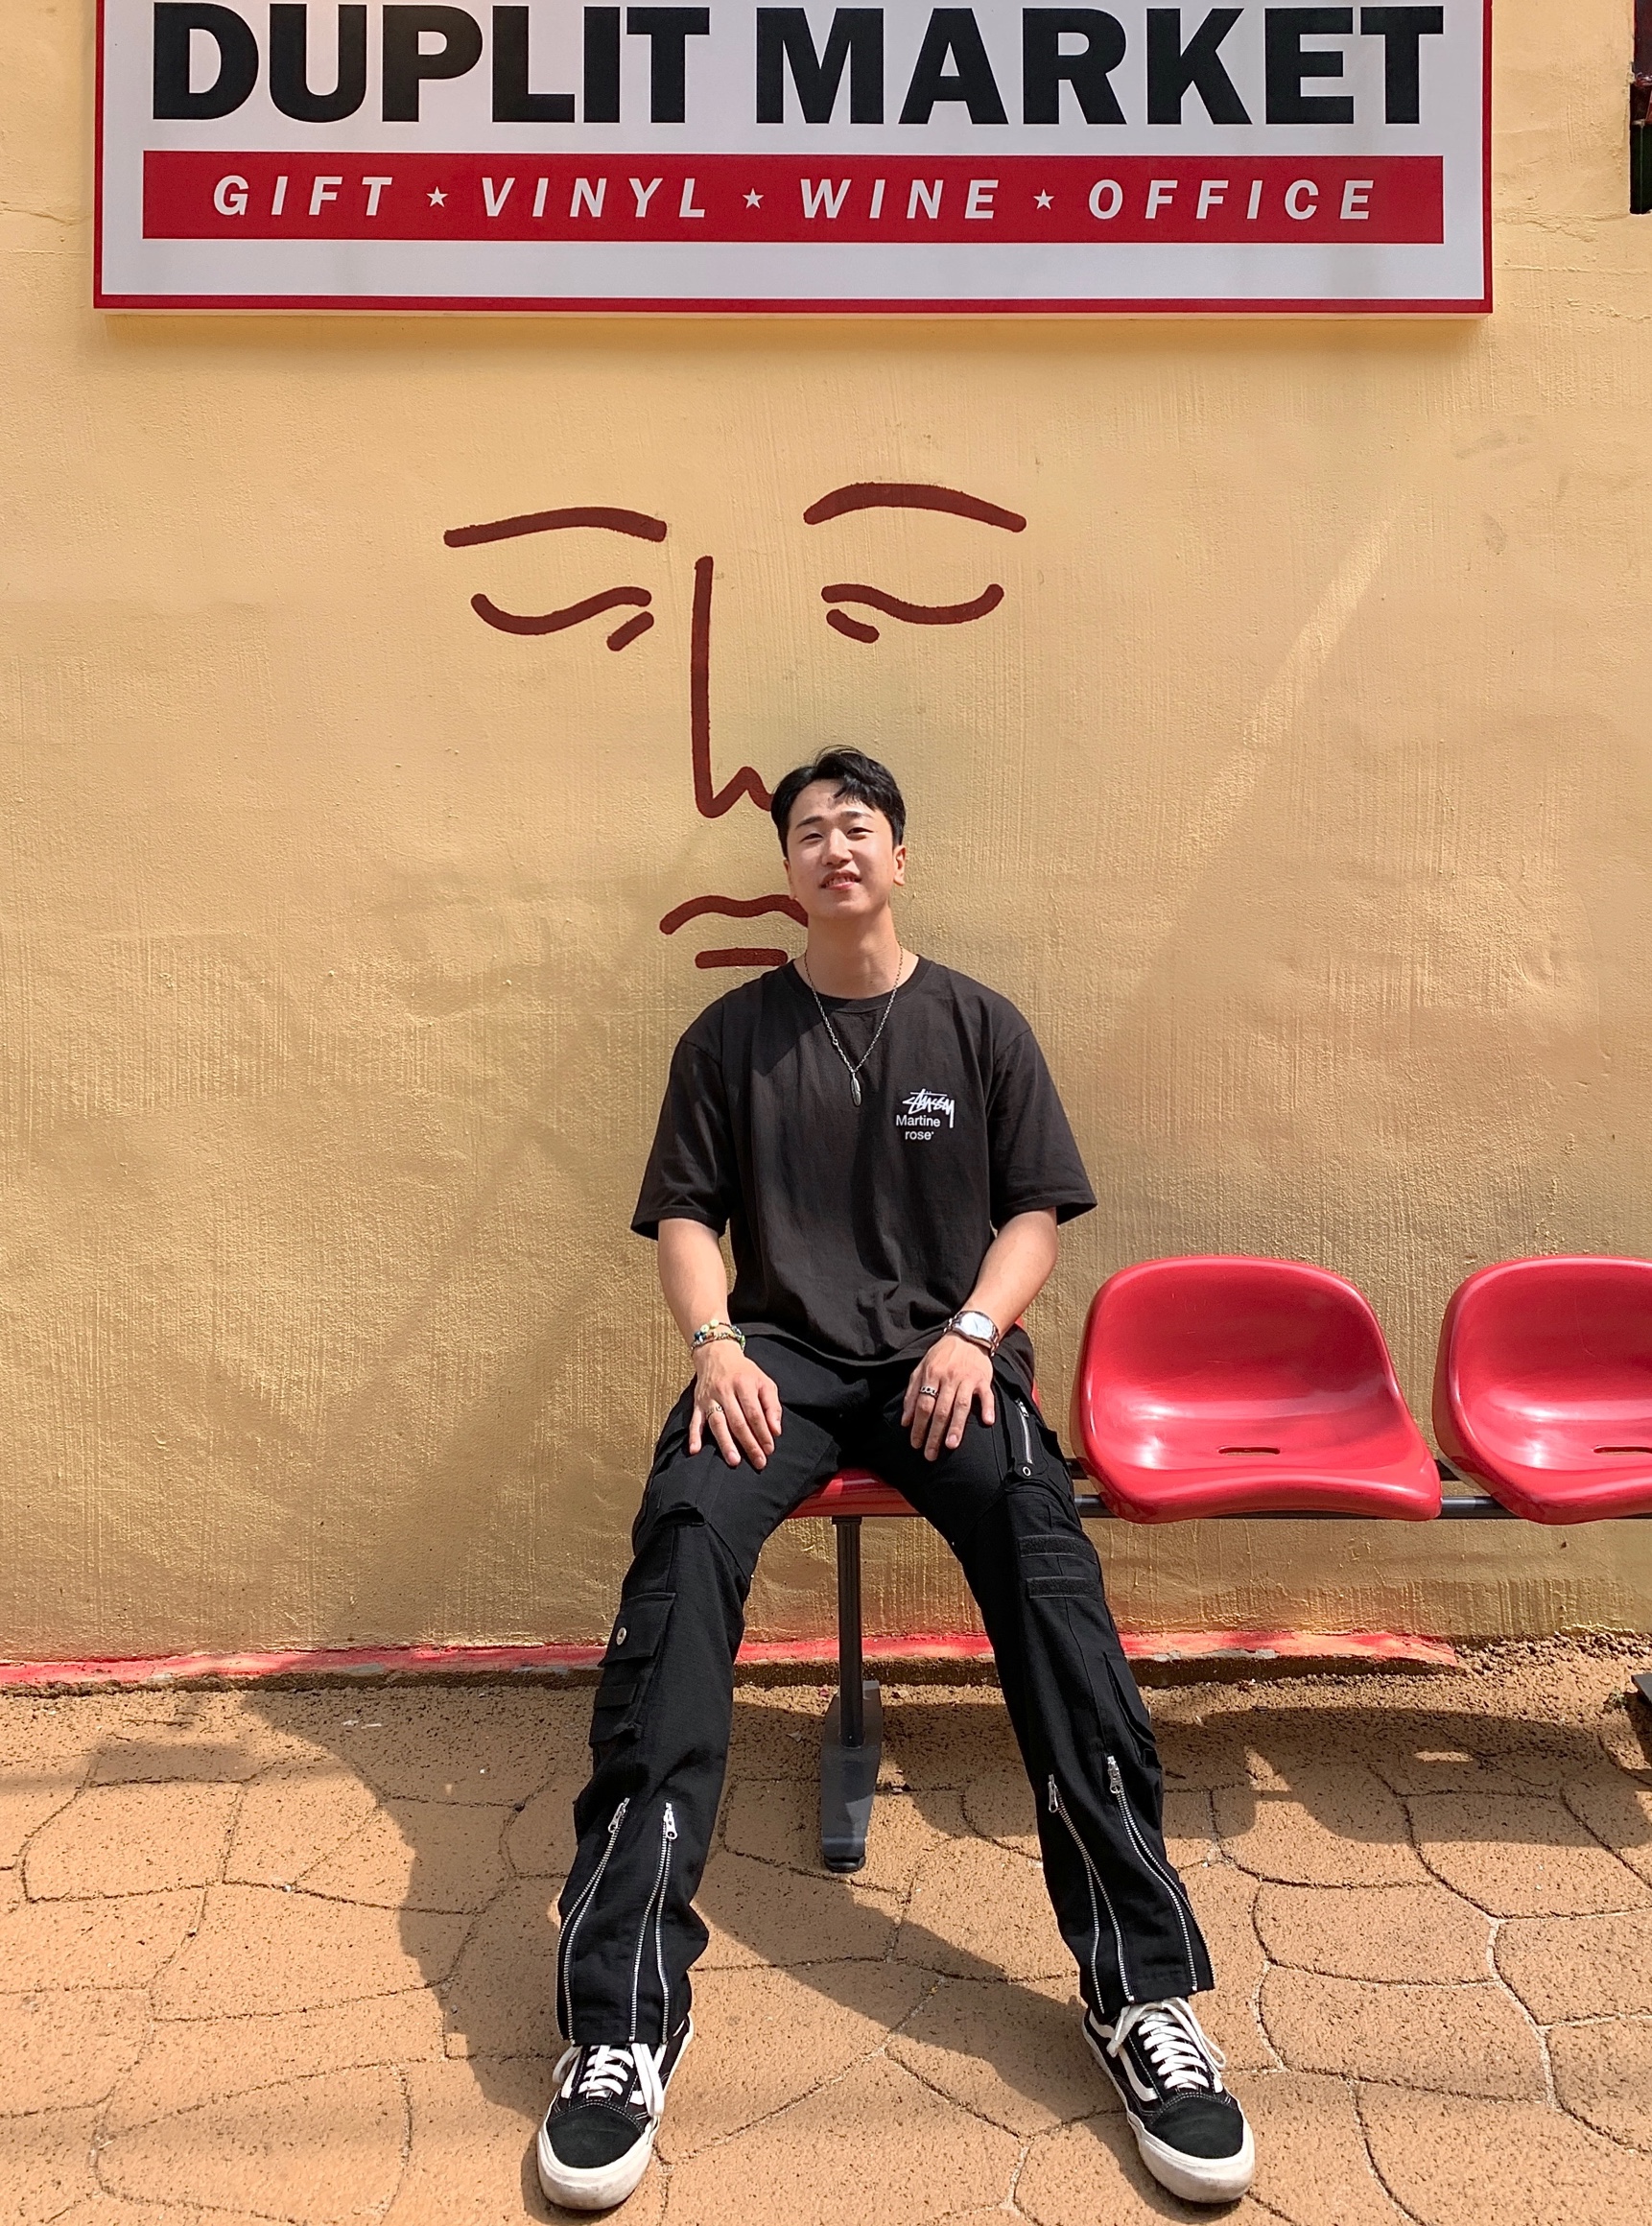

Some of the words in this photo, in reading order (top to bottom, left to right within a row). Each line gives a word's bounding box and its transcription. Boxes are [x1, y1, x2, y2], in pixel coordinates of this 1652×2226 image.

[153, 1, 710, 125] DUPLIT
[756, 5, 1445, 126] MARKET
[213, 175, 393, 217] GIFT
[482, 177, 706, 219] VINYL
[800, 178, 1000, 221] WINE
[1088, 178, 1375, 221] OFFICE
[895, 1114, 941, 1127] Martine
